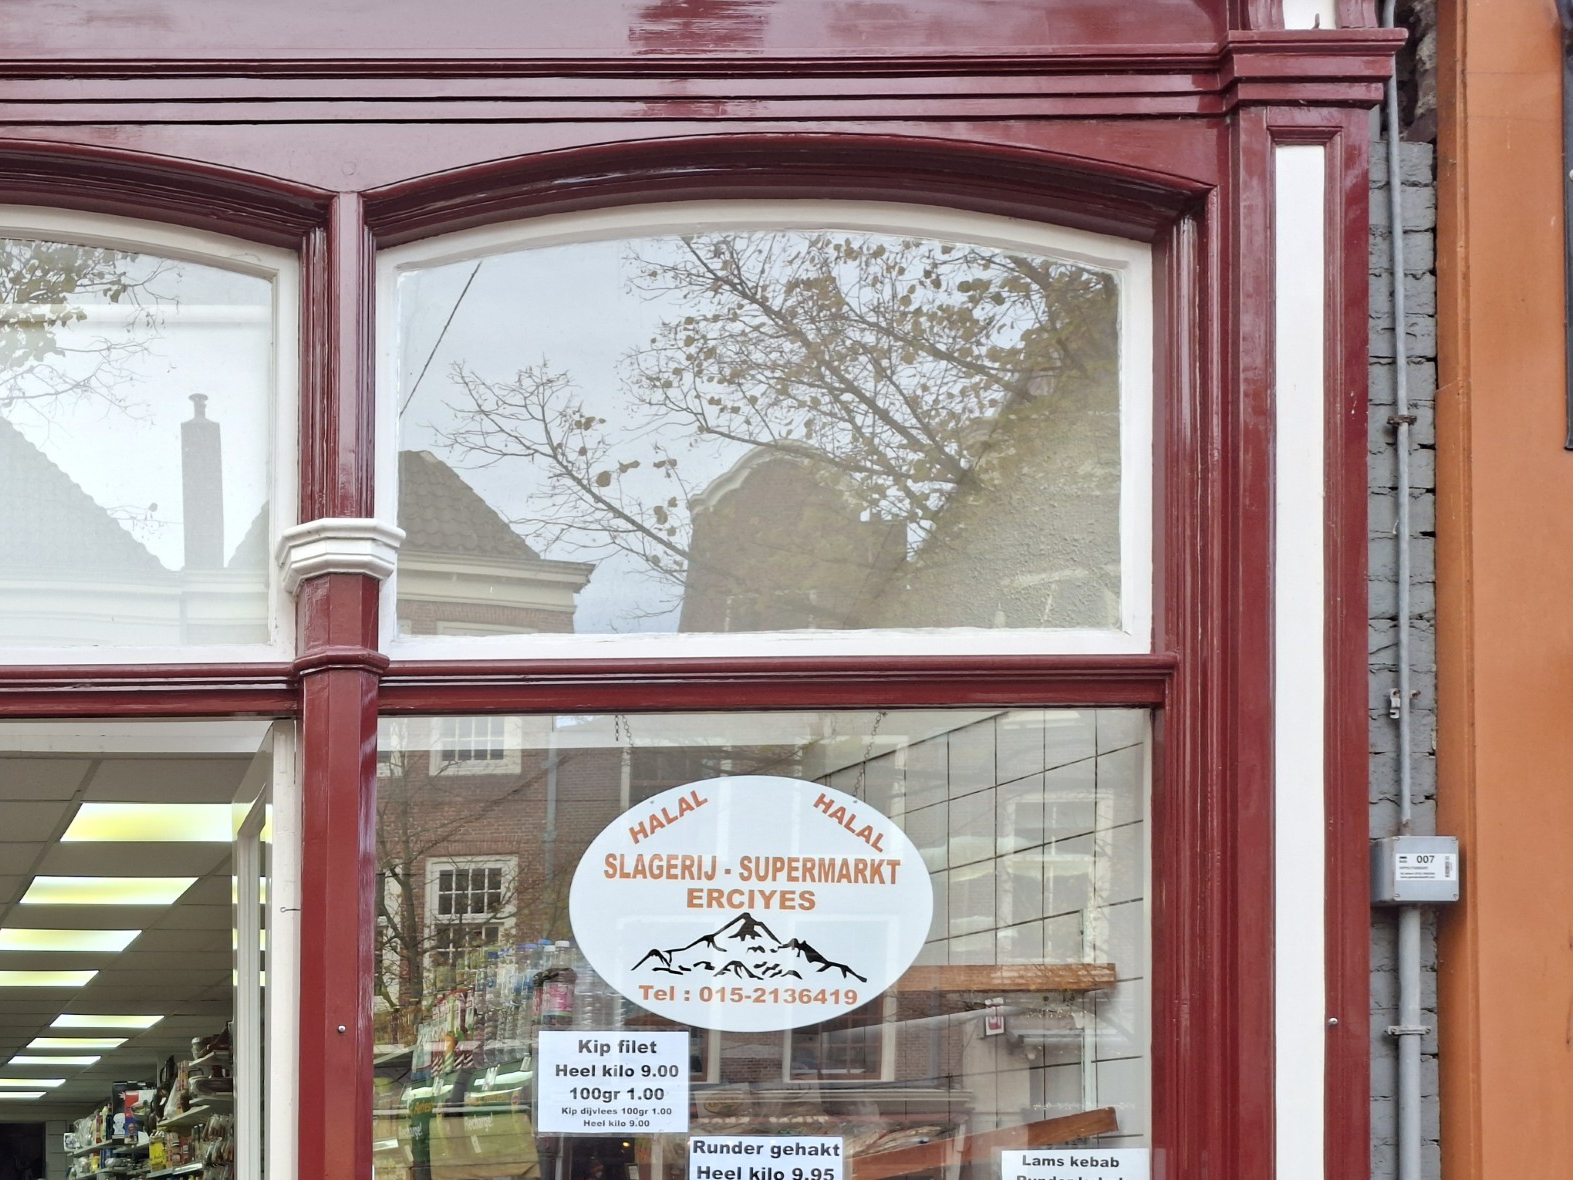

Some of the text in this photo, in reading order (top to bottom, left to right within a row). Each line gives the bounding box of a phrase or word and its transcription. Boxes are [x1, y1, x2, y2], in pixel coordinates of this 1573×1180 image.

[629, 790, 708, 844] HALAL
[813, 793, 886, 852] HALAL
[1416, 855, 1435, 864] 007
[604, 853, 717, 881] SLAGERIJ
[739, 856, 901, 886] SUPERMARKT
[686, 888, 816, 911] ERCIYES
[638, 984, 675, 1002] Tel
[699, 985, 858, 1006] 015-2136419
[578, 1039, 658, 1056] Kip filet
[555, 1064, 679, 1078] Heel kilo 9.00
[569, 1087, 665, 1103] 100gr 1.00
[561, 1106, 672, 1117] Kip dijvlees 100gr 1.00
[608, 1119, 627, 1127] kilo
[629, 1119, 650, 1127] 9.00
[692, 1140, 840, 1159] Runder gehakt
[1022, 1154, 1120, 1168] Lams kebab
[696, 1166, 742, 1180] Heel
[749, 1166, 785, 1180] kilo
